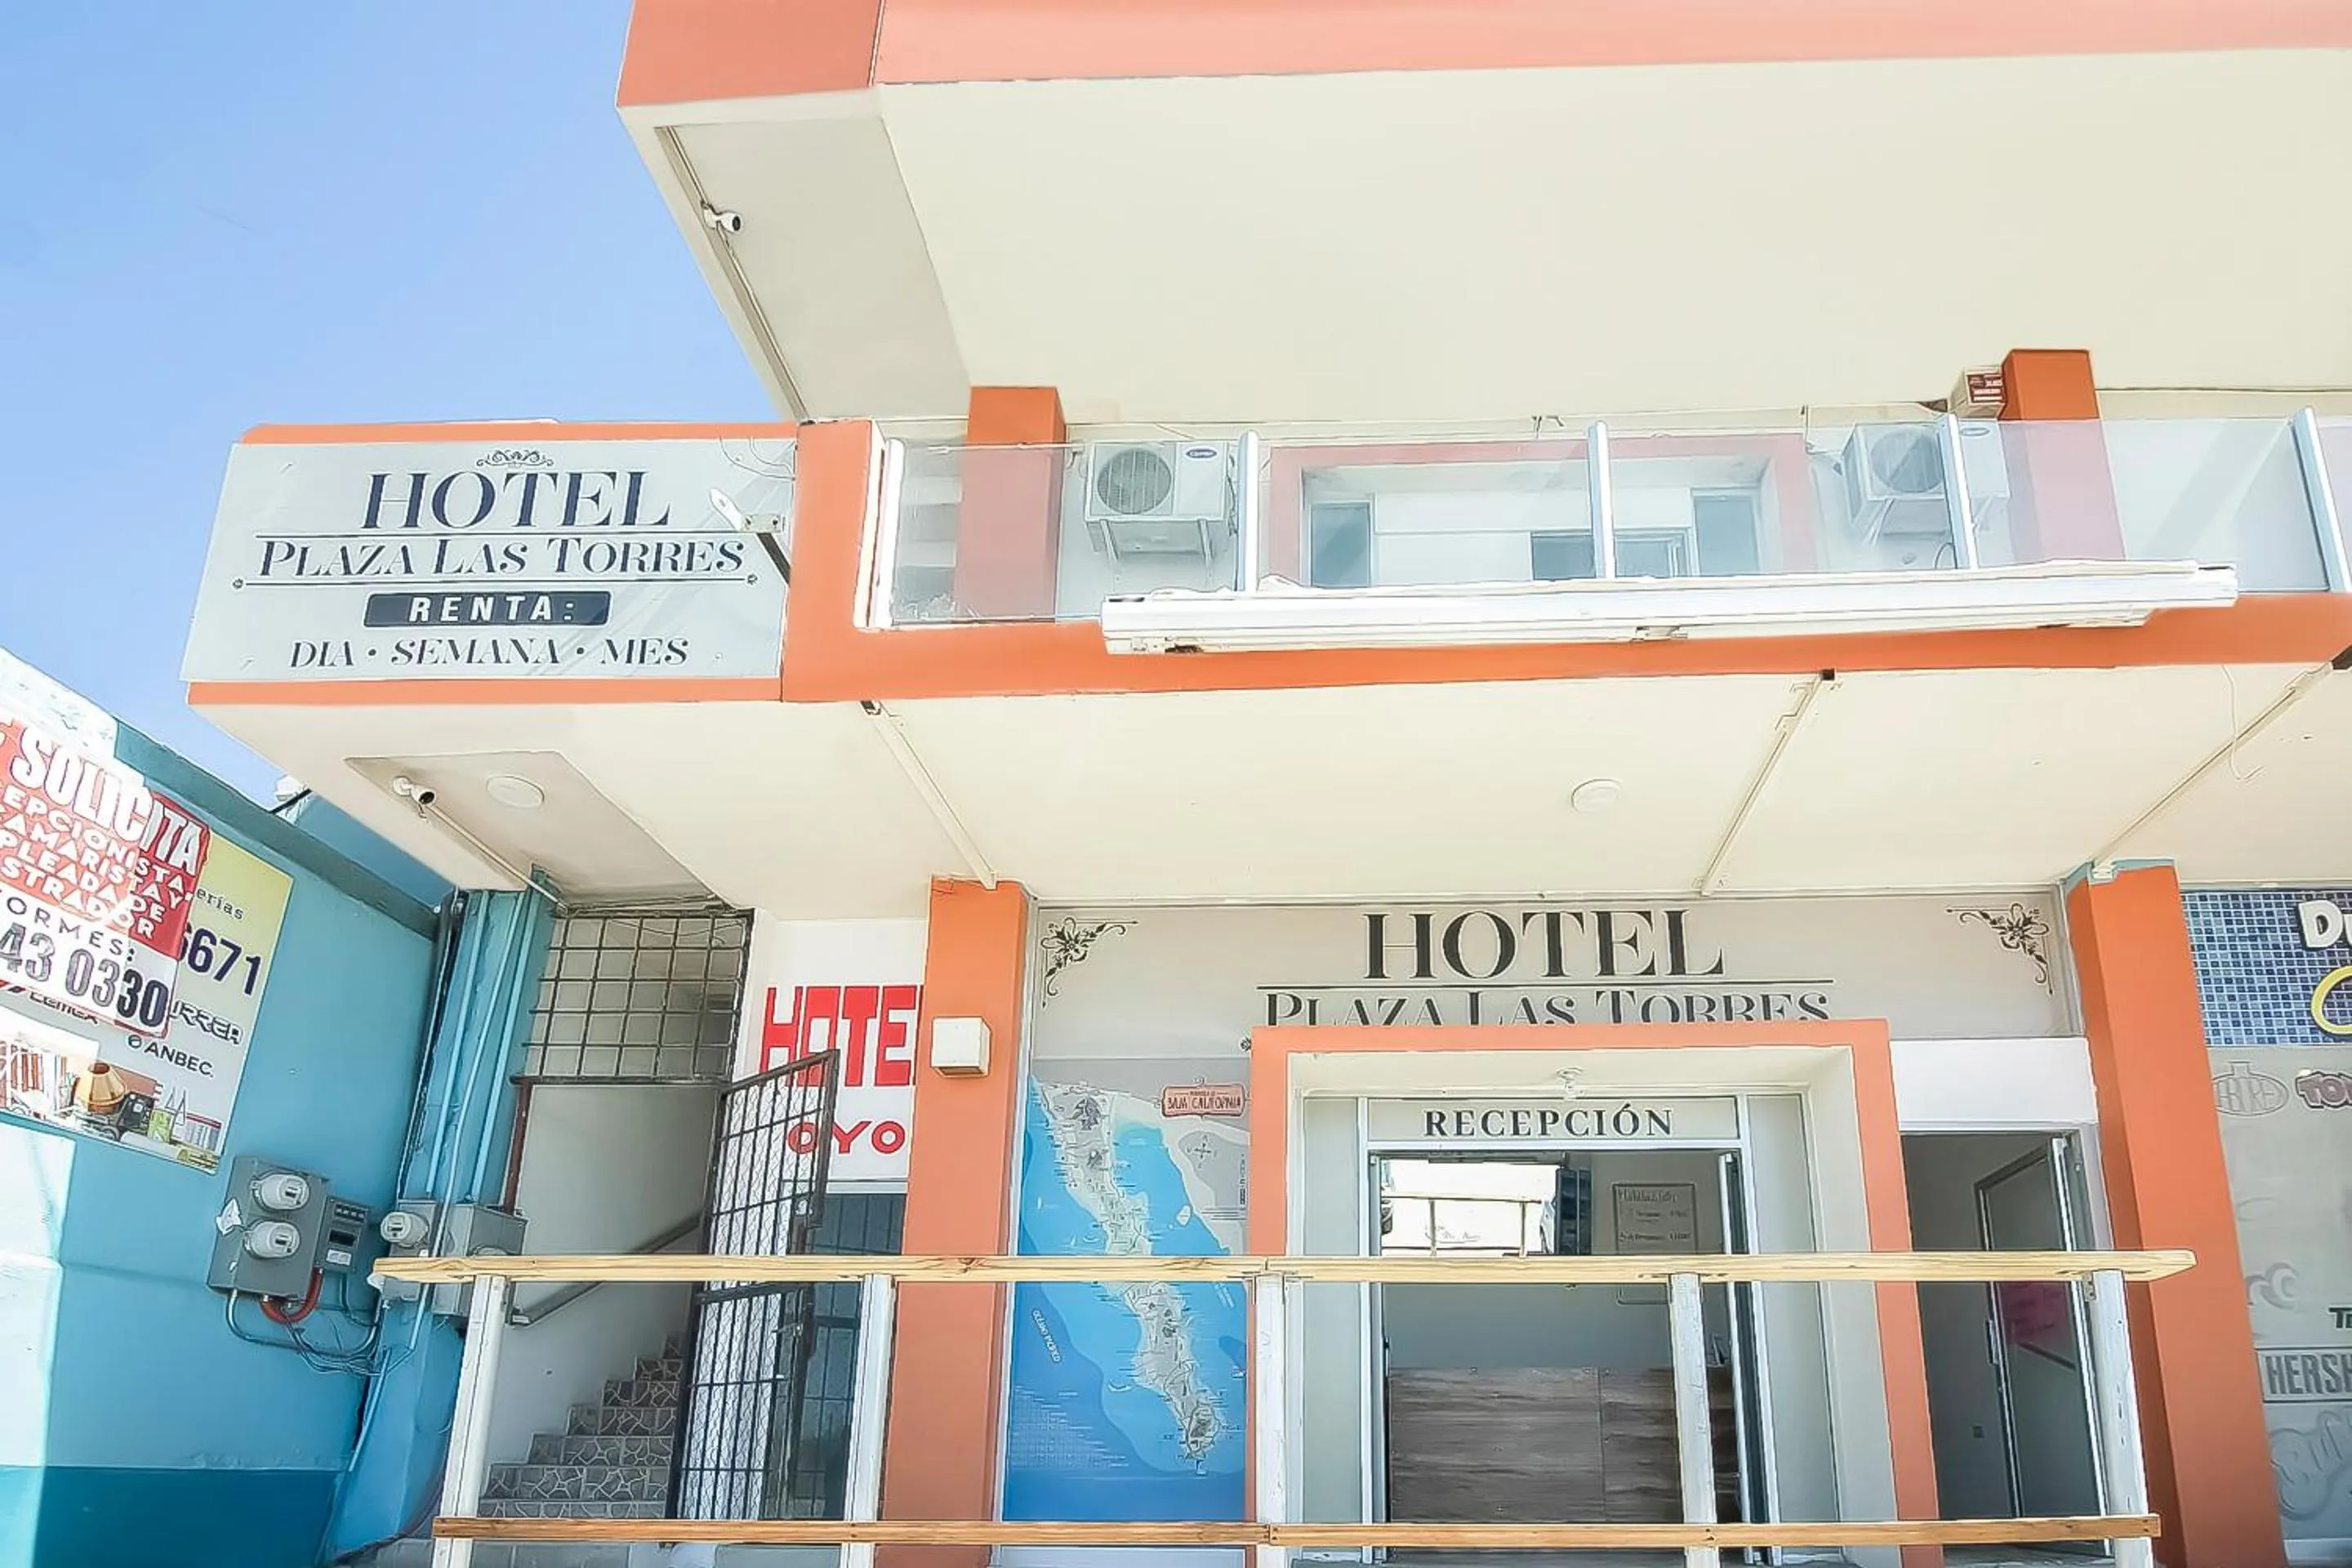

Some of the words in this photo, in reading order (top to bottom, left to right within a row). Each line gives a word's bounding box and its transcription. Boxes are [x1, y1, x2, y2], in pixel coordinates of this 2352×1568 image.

[361, 470, 671, 529] HOTEL
[260, 539, 413, 577] PLAZA
[434, 538, 528, 575] LAS
[547, 537, 746, 573] TORRES
[409, 595, 576, 622] RENTA:
[290, 640, 354, 668] DIA
[391, 639, 560, 666] SEMANA
[600, 638, 688, 666] MES
[10, 726, 203, 877] SOLICITA
[0, 804, 163, 902] AMARISTA
[0, 889, 135, 962] ORMES:
[1364, 909, 1724, 980] HOTEL
[2298, 900, 2352, 947] D
[179, 921, 261, 996] 671
[1267, 992, 1442, 1026] PLAZA
[1468, 991, 1576, 1025] LAS
[1596, 990, 1829, 1023] TORRES
[759, 985, 924, 1087] HOTE
[787, 1121, 906, 1154] OYO
[1423, 1102, 1674, 1138] RECEPCIÓN
